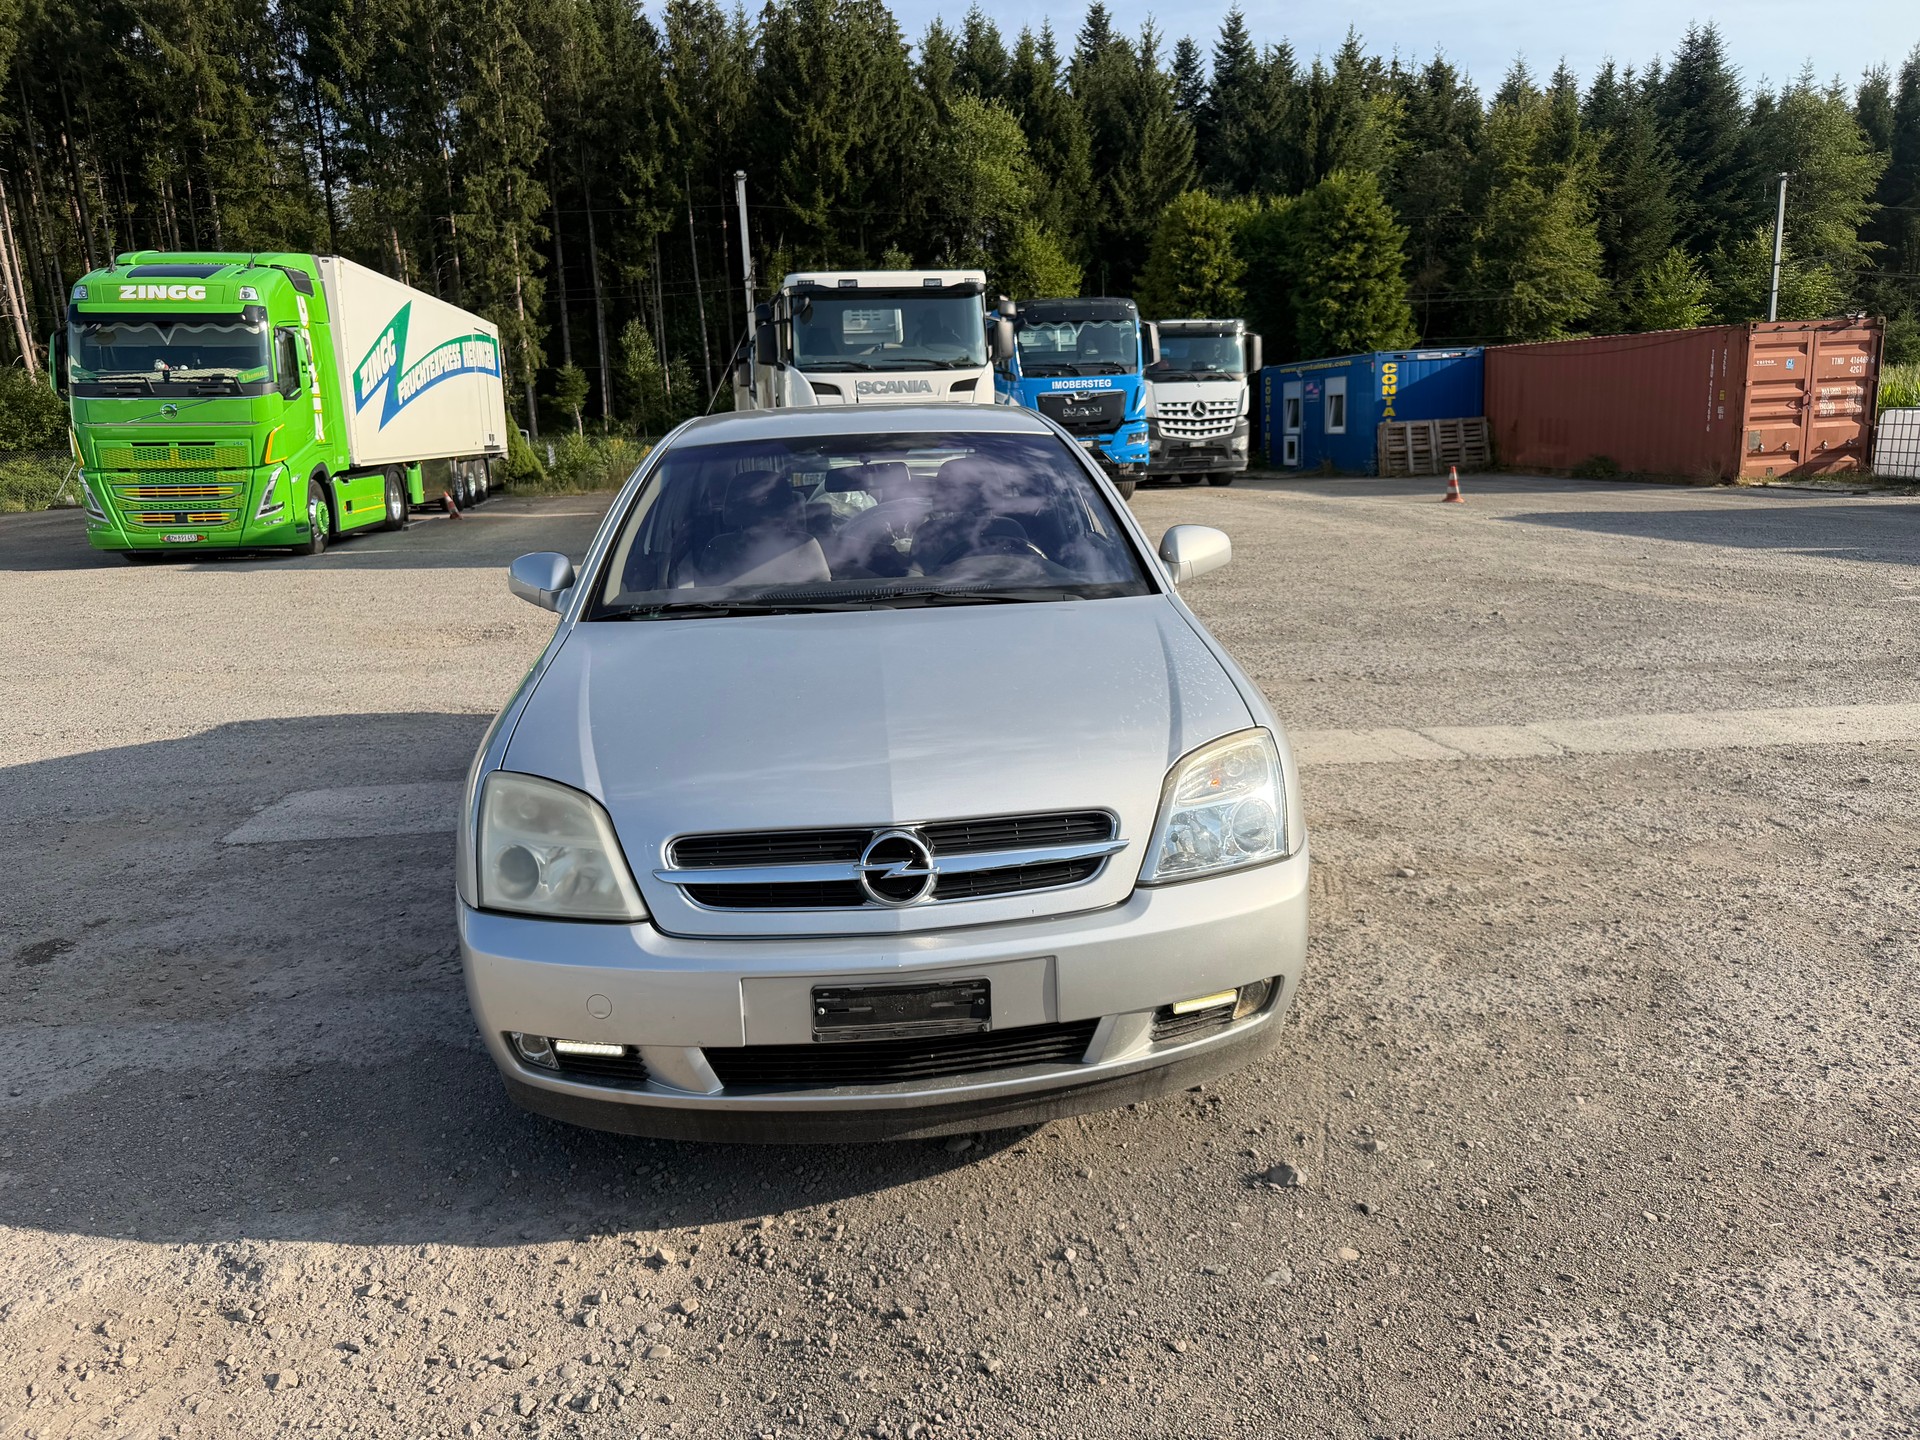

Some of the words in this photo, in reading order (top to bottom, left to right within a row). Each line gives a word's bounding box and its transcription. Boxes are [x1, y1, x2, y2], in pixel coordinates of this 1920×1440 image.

[119, 285, 206, 301] ZINGG
[359, 327, 397, 400] ZINGG
[397, 342, 462, 406] FRUCHTEXPRESS
[857, 380, 933, 394] SCANIA
[1051, 379, 1112, 390] IMOBERSTEG
[1062, 406, 1102, 417] MAN
